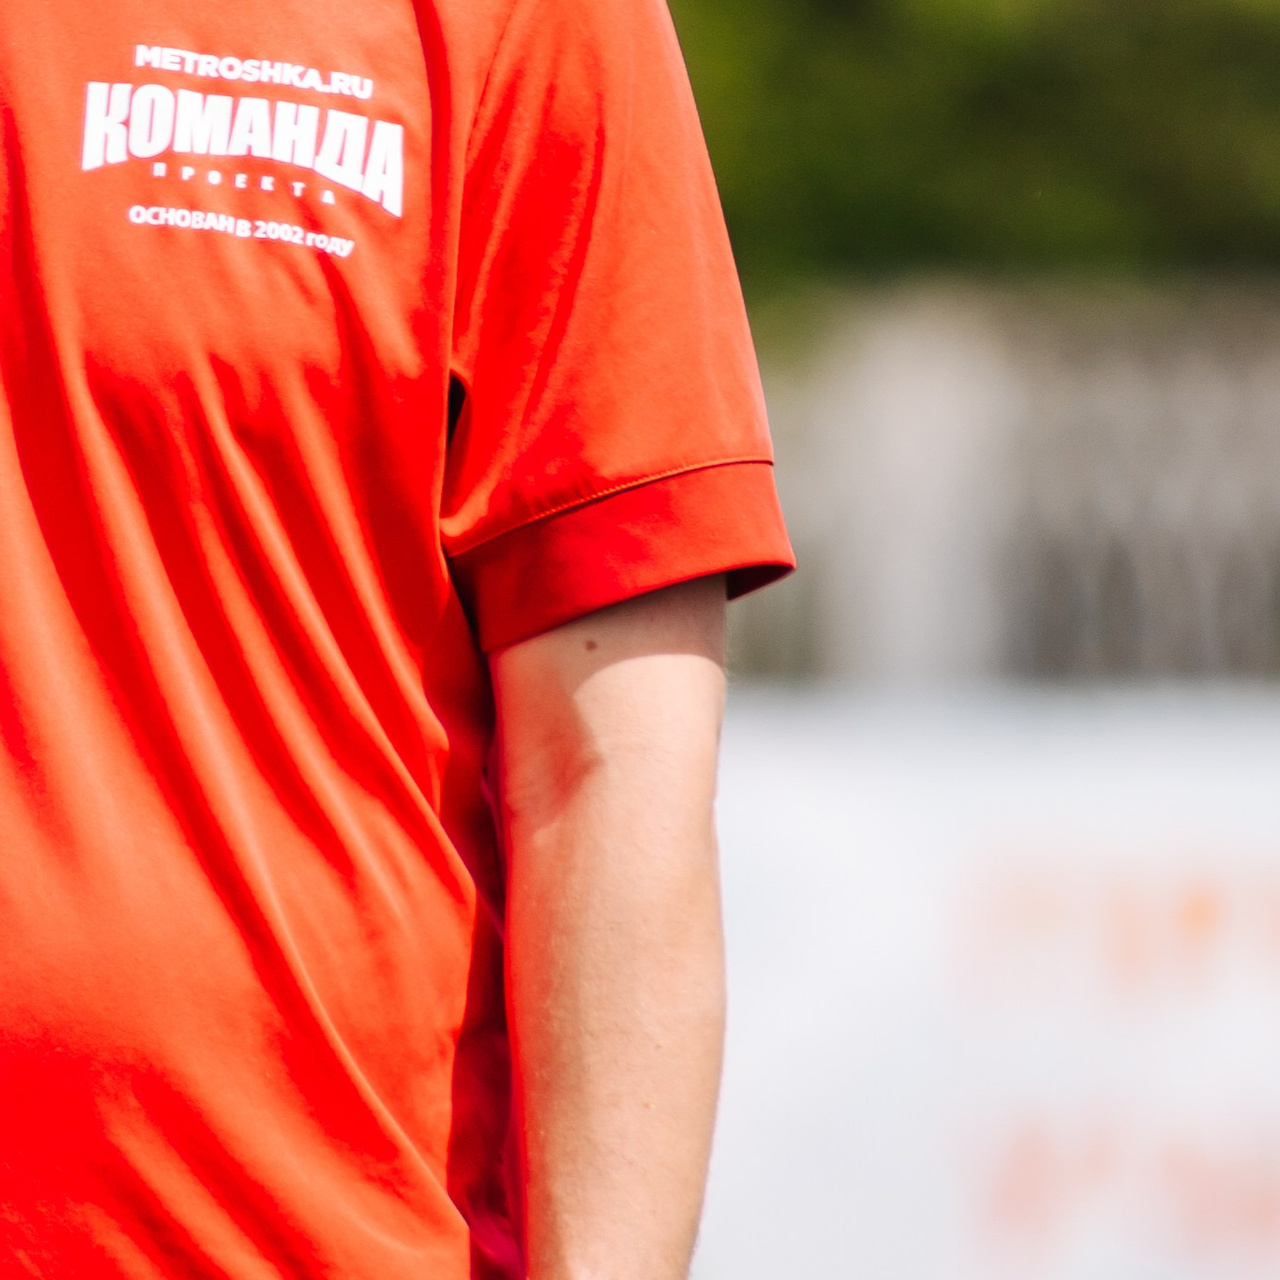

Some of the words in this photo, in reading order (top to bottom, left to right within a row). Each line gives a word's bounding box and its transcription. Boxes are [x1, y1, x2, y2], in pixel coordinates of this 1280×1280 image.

[133, 43, 376, 101] METROSHKA.RU
[80, 80, 405, 219] КОМАНДА
[127, 203, 235, 235] ОСНОВАН
[252, 219, 305, 246] 2002
